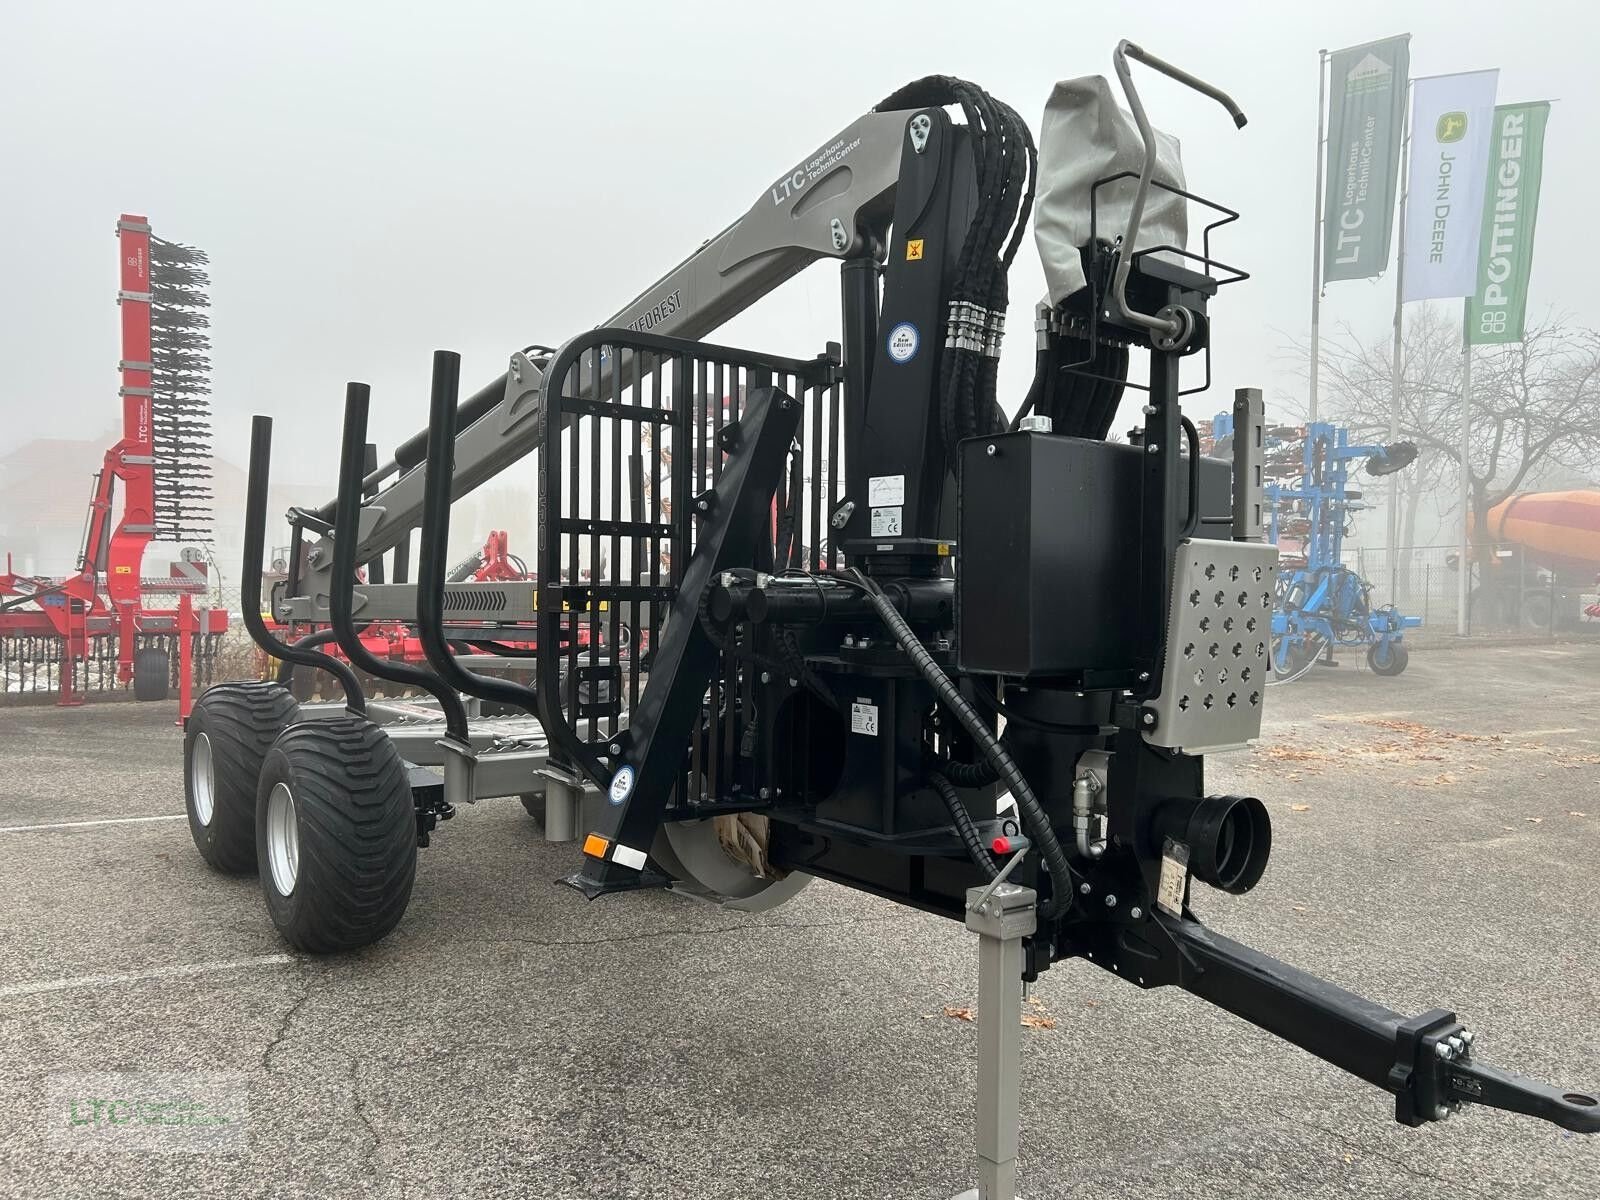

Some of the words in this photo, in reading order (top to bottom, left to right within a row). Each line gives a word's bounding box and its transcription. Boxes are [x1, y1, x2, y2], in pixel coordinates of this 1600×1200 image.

[805, 139, 845, 172] Lagerhaus
[807, 137, 861, 181] TechnikCenter
[1343, 140, 1360, 206] Lagerhaus
[1356, 115, 1376, 204] TechnikCenter
[1436, 152, 1456, 200] JOHN
[772, 170, 806, 206] LTC
[1484, 112, 1524, 306] PÖTTINGER
[1335, 207, 1365, 264] LTC
[1429, 205, 1450, 264] DEERE
[138, 425, 148, 443] LTC
